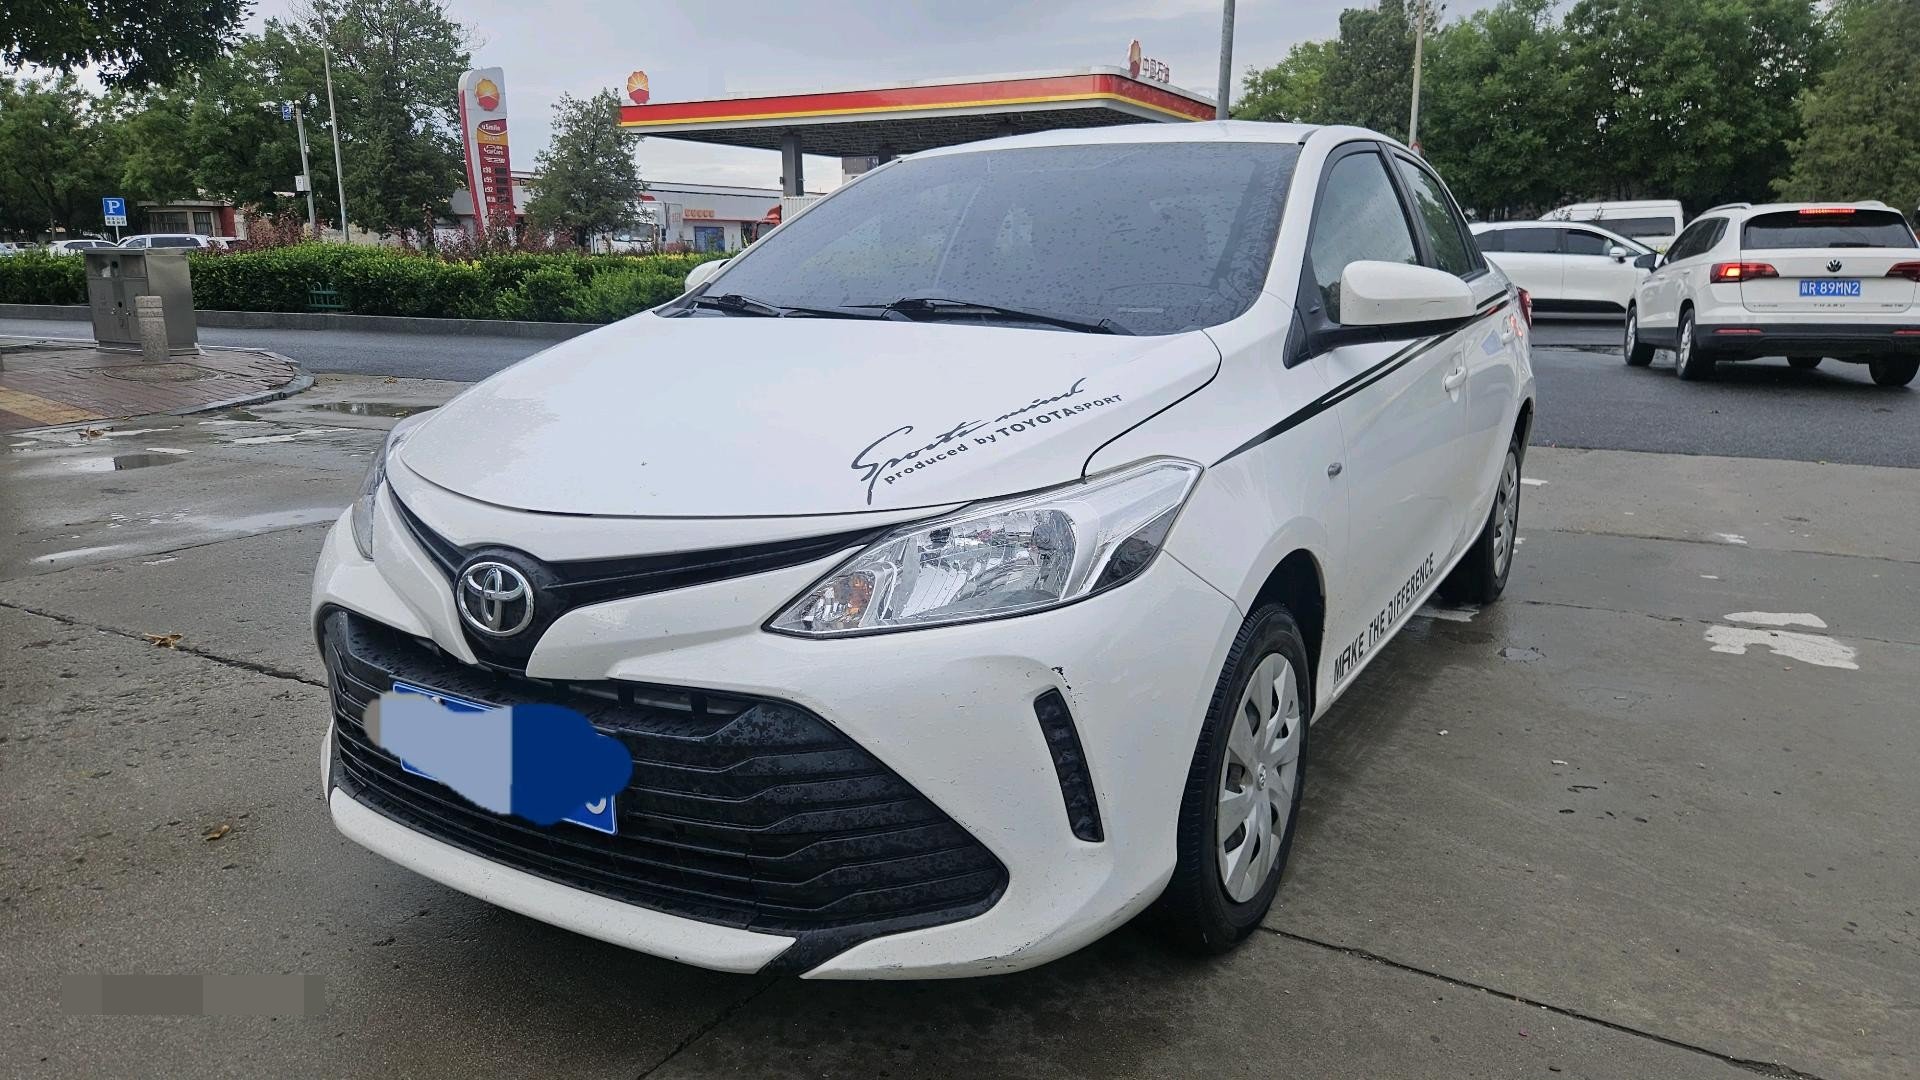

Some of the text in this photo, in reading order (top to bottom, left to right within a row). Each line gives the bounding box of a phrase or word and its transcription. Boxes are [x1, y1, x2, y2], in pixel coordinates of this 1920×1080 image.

[106, 200, 121, 214] P
[884, 443, 969, 485] produced
[974, 434, 997, 445] by
[1333, 551, 1434, 685] MAKE THE DIFFERENCE
